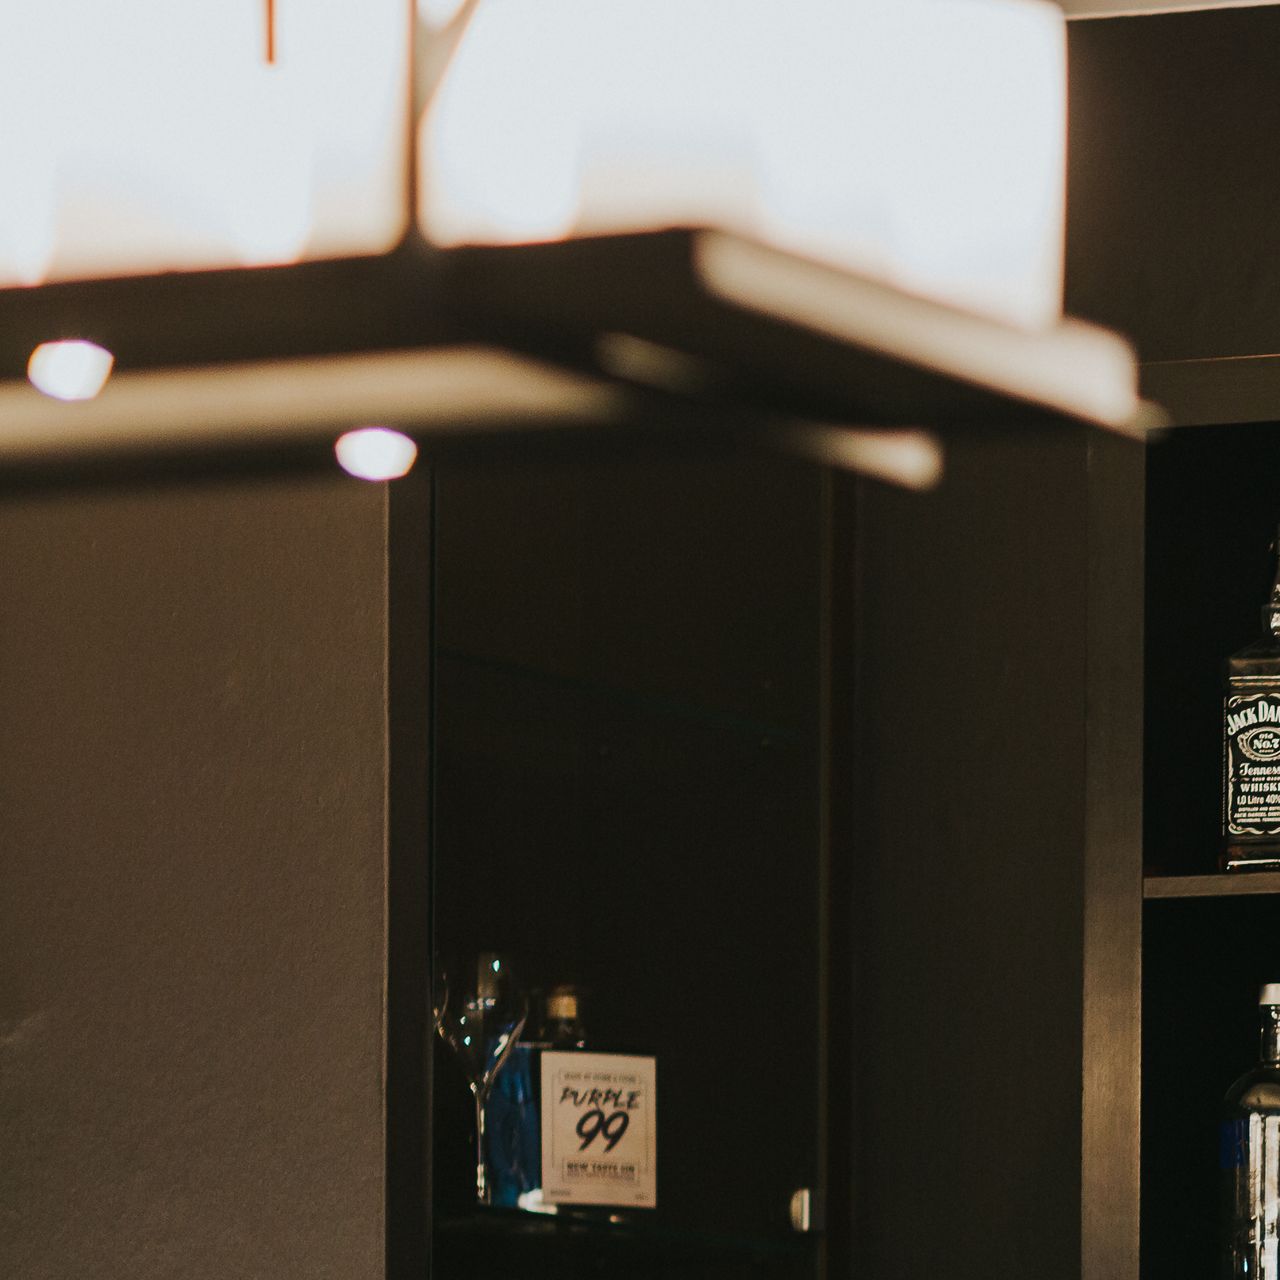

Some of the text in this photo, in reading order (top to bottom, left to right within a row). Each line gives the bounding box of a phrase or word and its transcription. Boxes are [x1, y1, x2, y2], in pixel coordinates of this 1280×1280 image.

[1227, 707, 1257, 735] JACK
[1253, 739, 1279, 749] No.7
[1247, 794, 1280, 804] Litre 40%
[559, 1087, 641, 1109] PURPLE
[575, 1109, 630, 1153] 99
